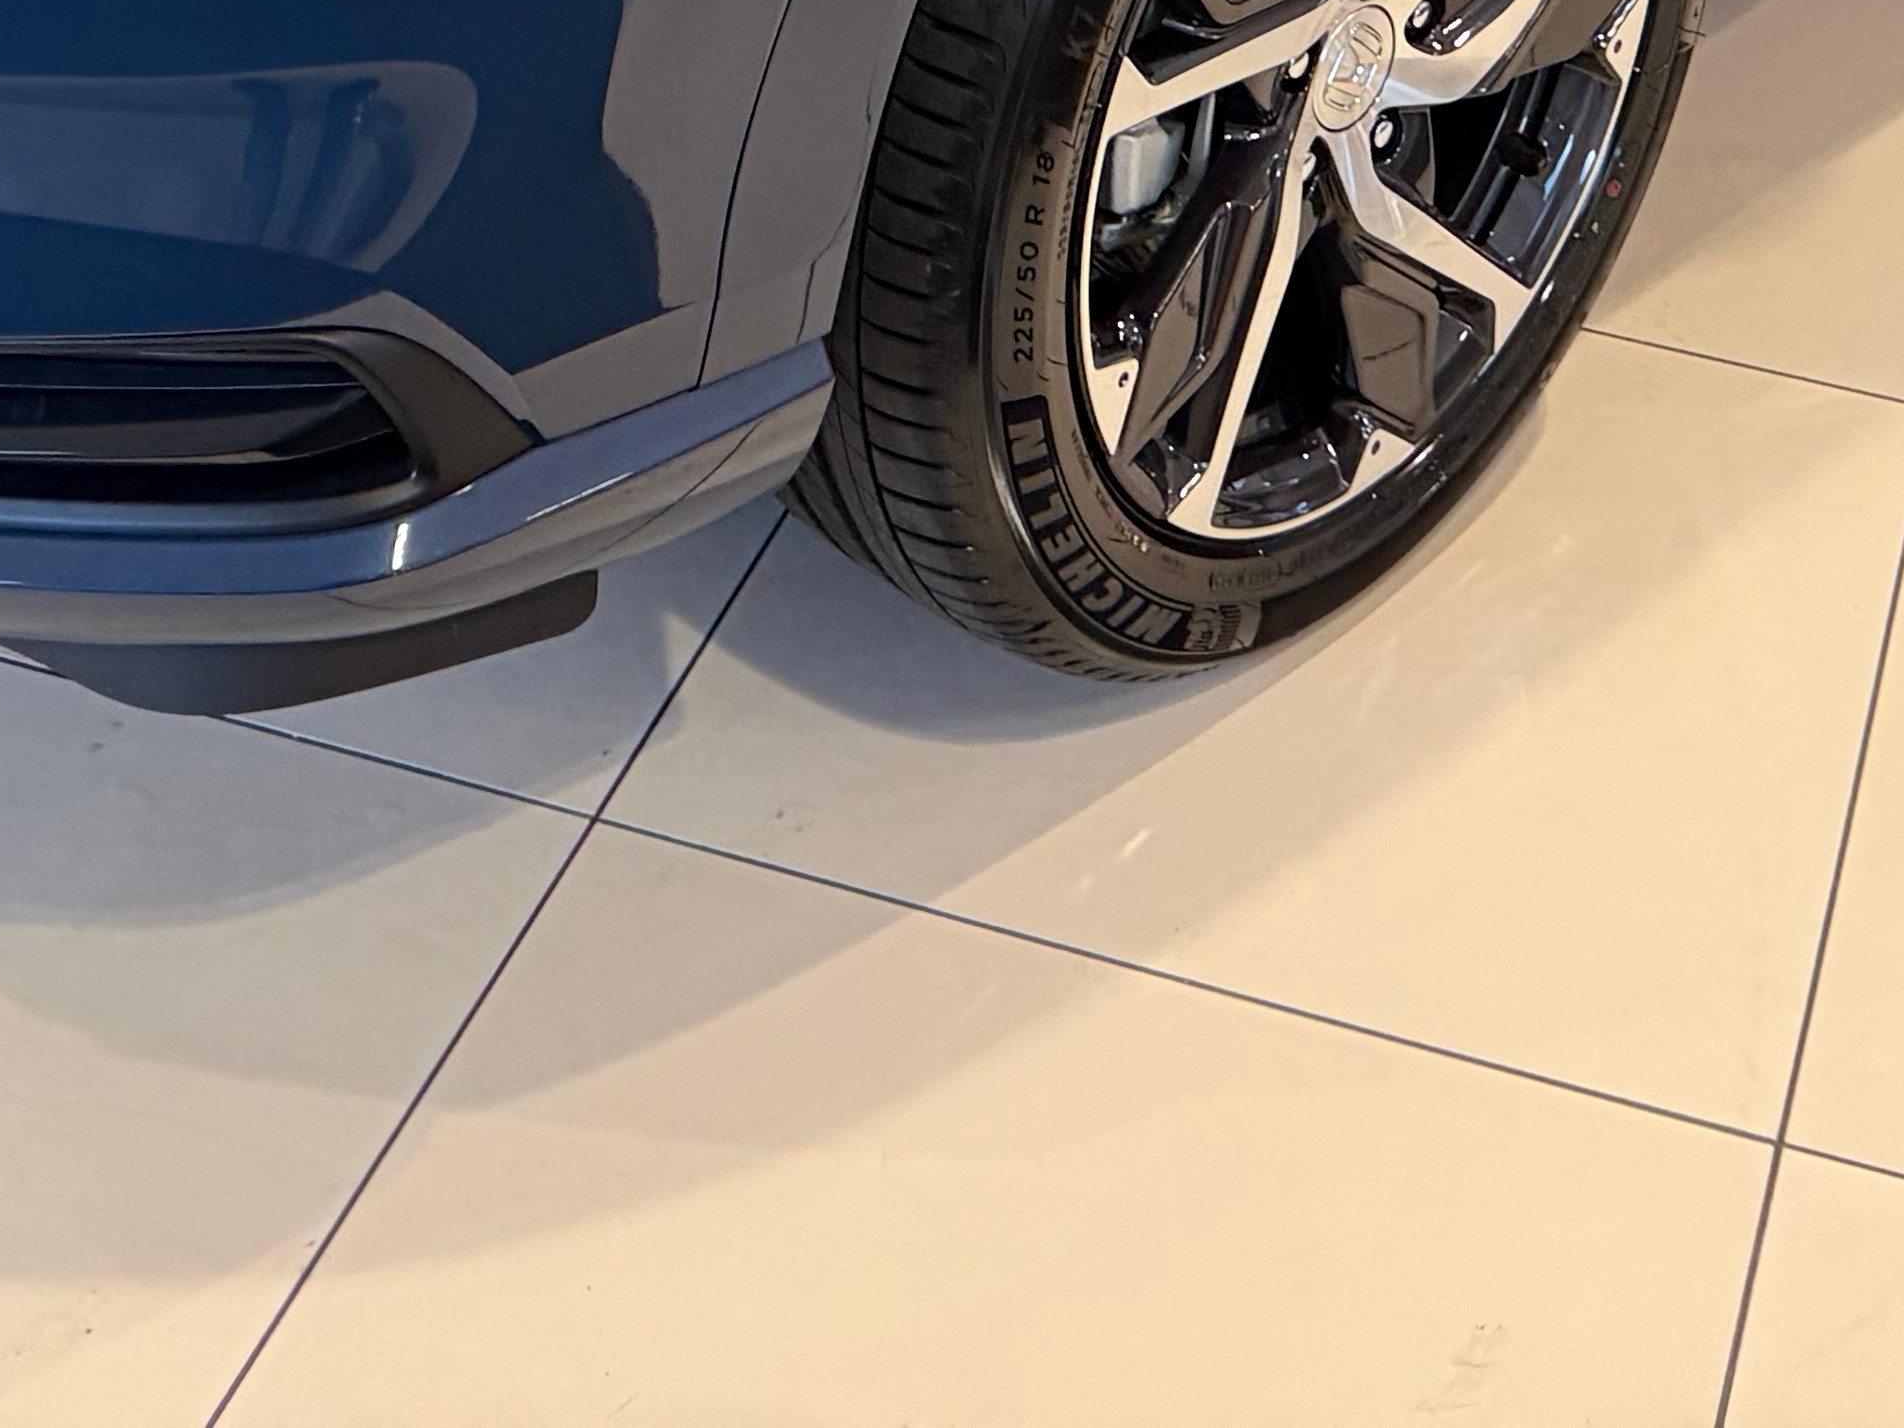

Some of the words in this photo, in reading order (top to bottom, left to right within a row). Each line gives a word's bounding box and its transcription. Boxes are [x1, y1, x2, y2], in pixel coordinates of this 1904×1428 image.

[1032, 150, 1056, 185] 18
[1024, 203, 1047, 226] R
[1012, 241, 1040, 364] 225/50
[1005, 416, 1184, 645] MICHELIN
